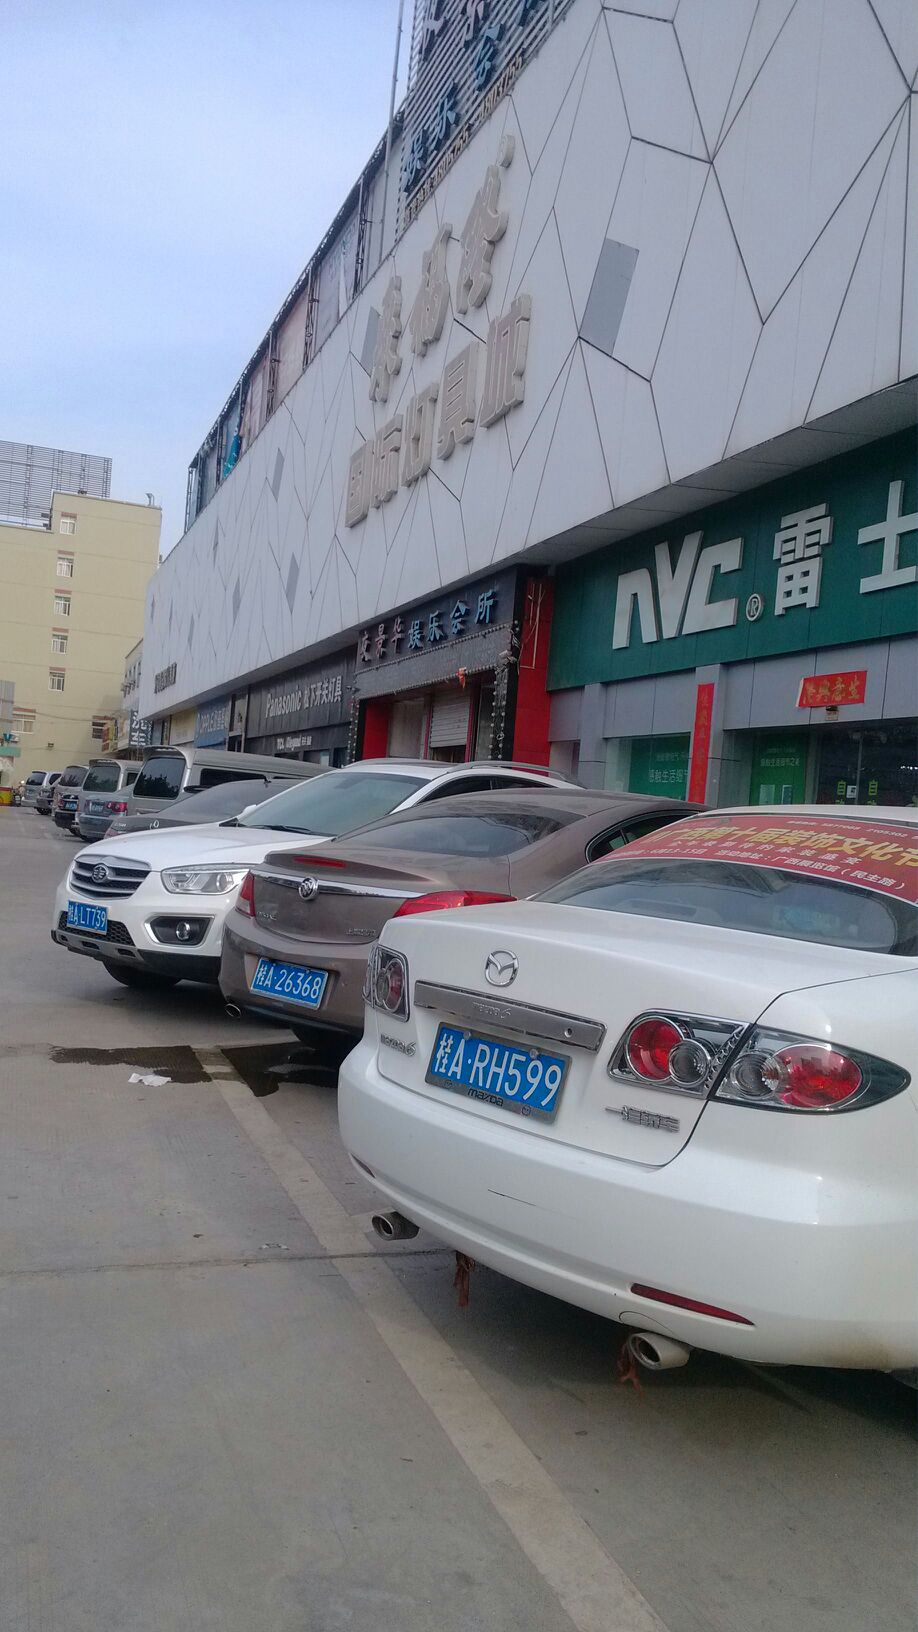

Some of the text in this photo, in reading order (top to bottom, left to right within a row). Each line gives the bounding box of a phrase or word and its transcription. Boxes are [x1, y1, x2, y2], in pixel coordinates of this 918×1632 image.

[613, 530, 743, 650] NVC
[265, 684, 302, 719] Panasonic
[255, 961, 322, 999] 桂A·26368
[433, 1032, 562, 1107] 桂A·RH599
